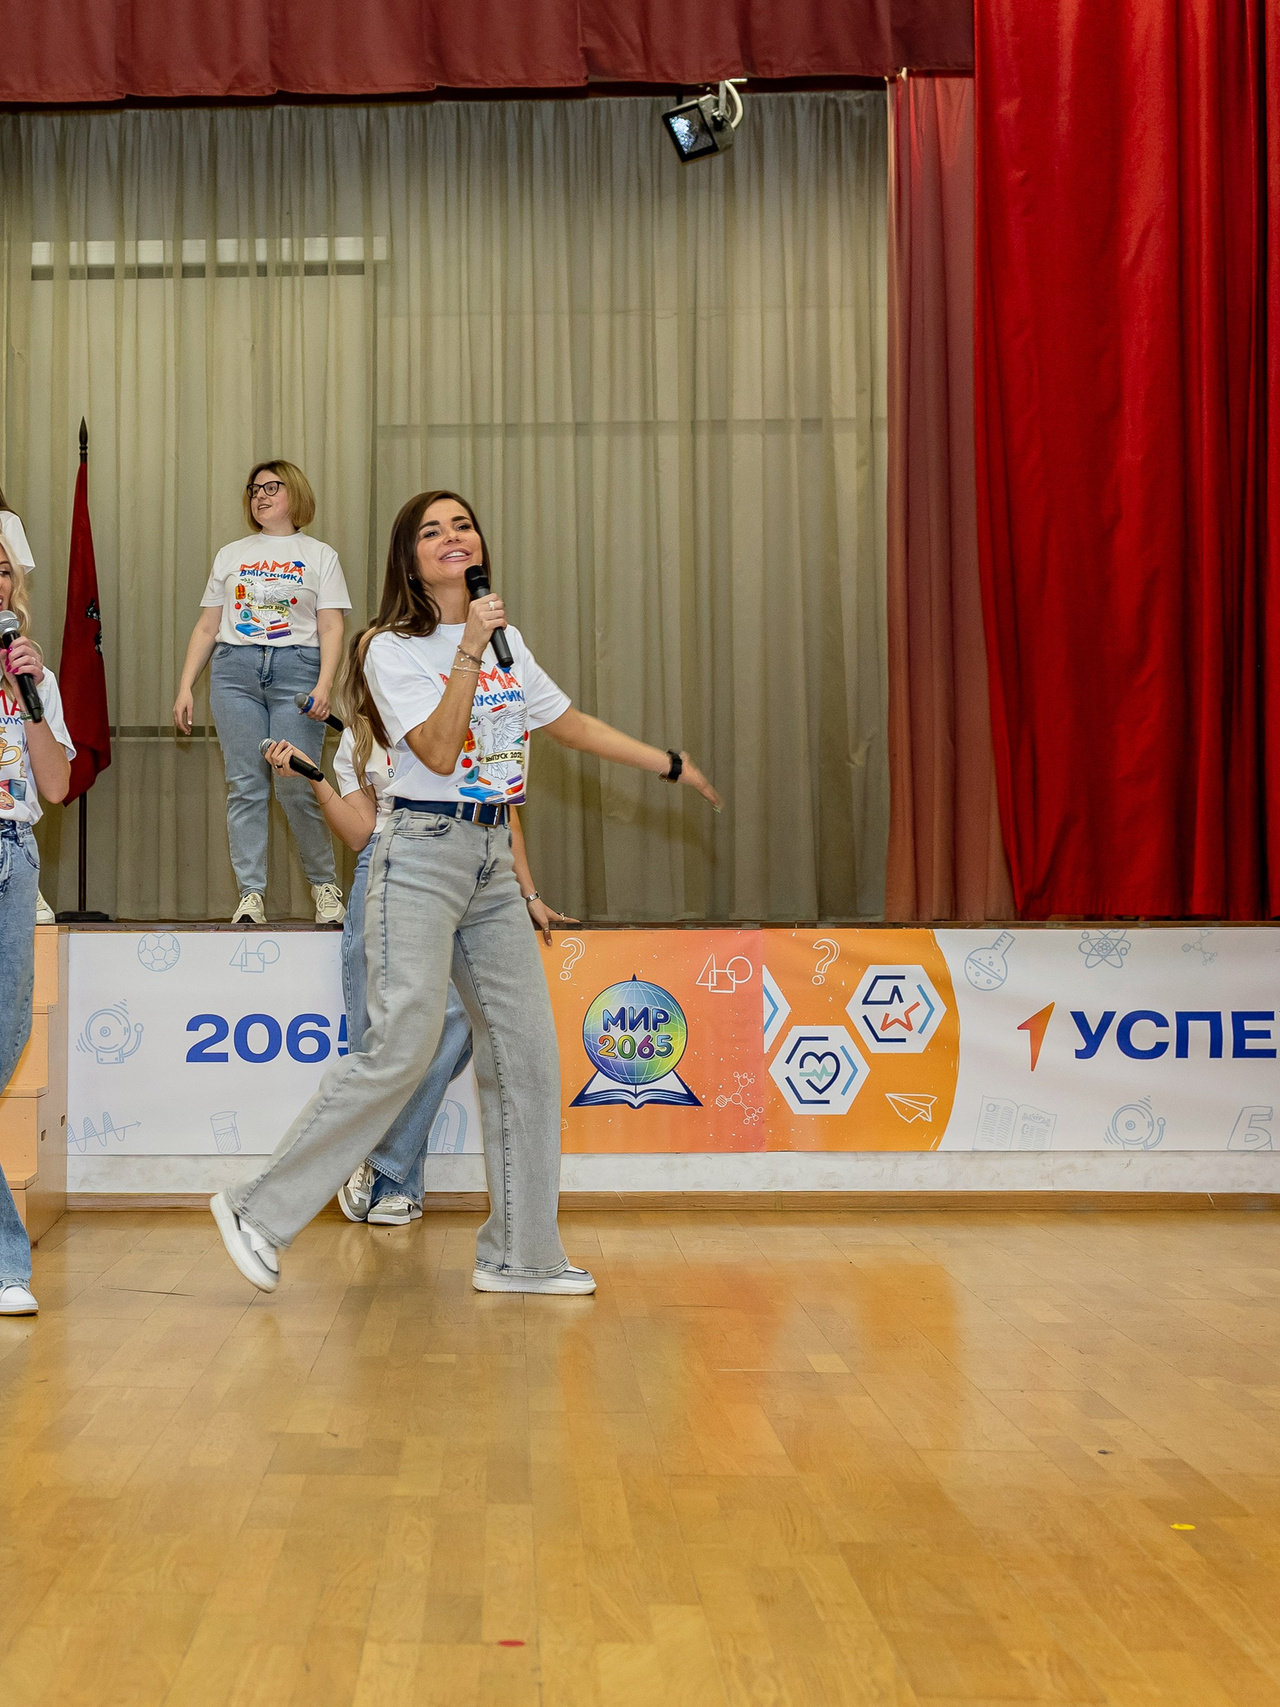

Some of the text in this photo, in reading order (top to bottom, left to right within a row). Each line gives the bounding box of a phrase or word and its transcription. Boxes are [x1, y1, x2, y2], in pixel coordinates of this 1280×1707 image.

[240, 560, 303, 577] МАМА
[439, 666, 522, 693] МА
[601, 1005, 673, 1032] МИР
[598, 1034, 675, 1060] 2065
[1070, 1009, 1280, 1060] УСПЕ
